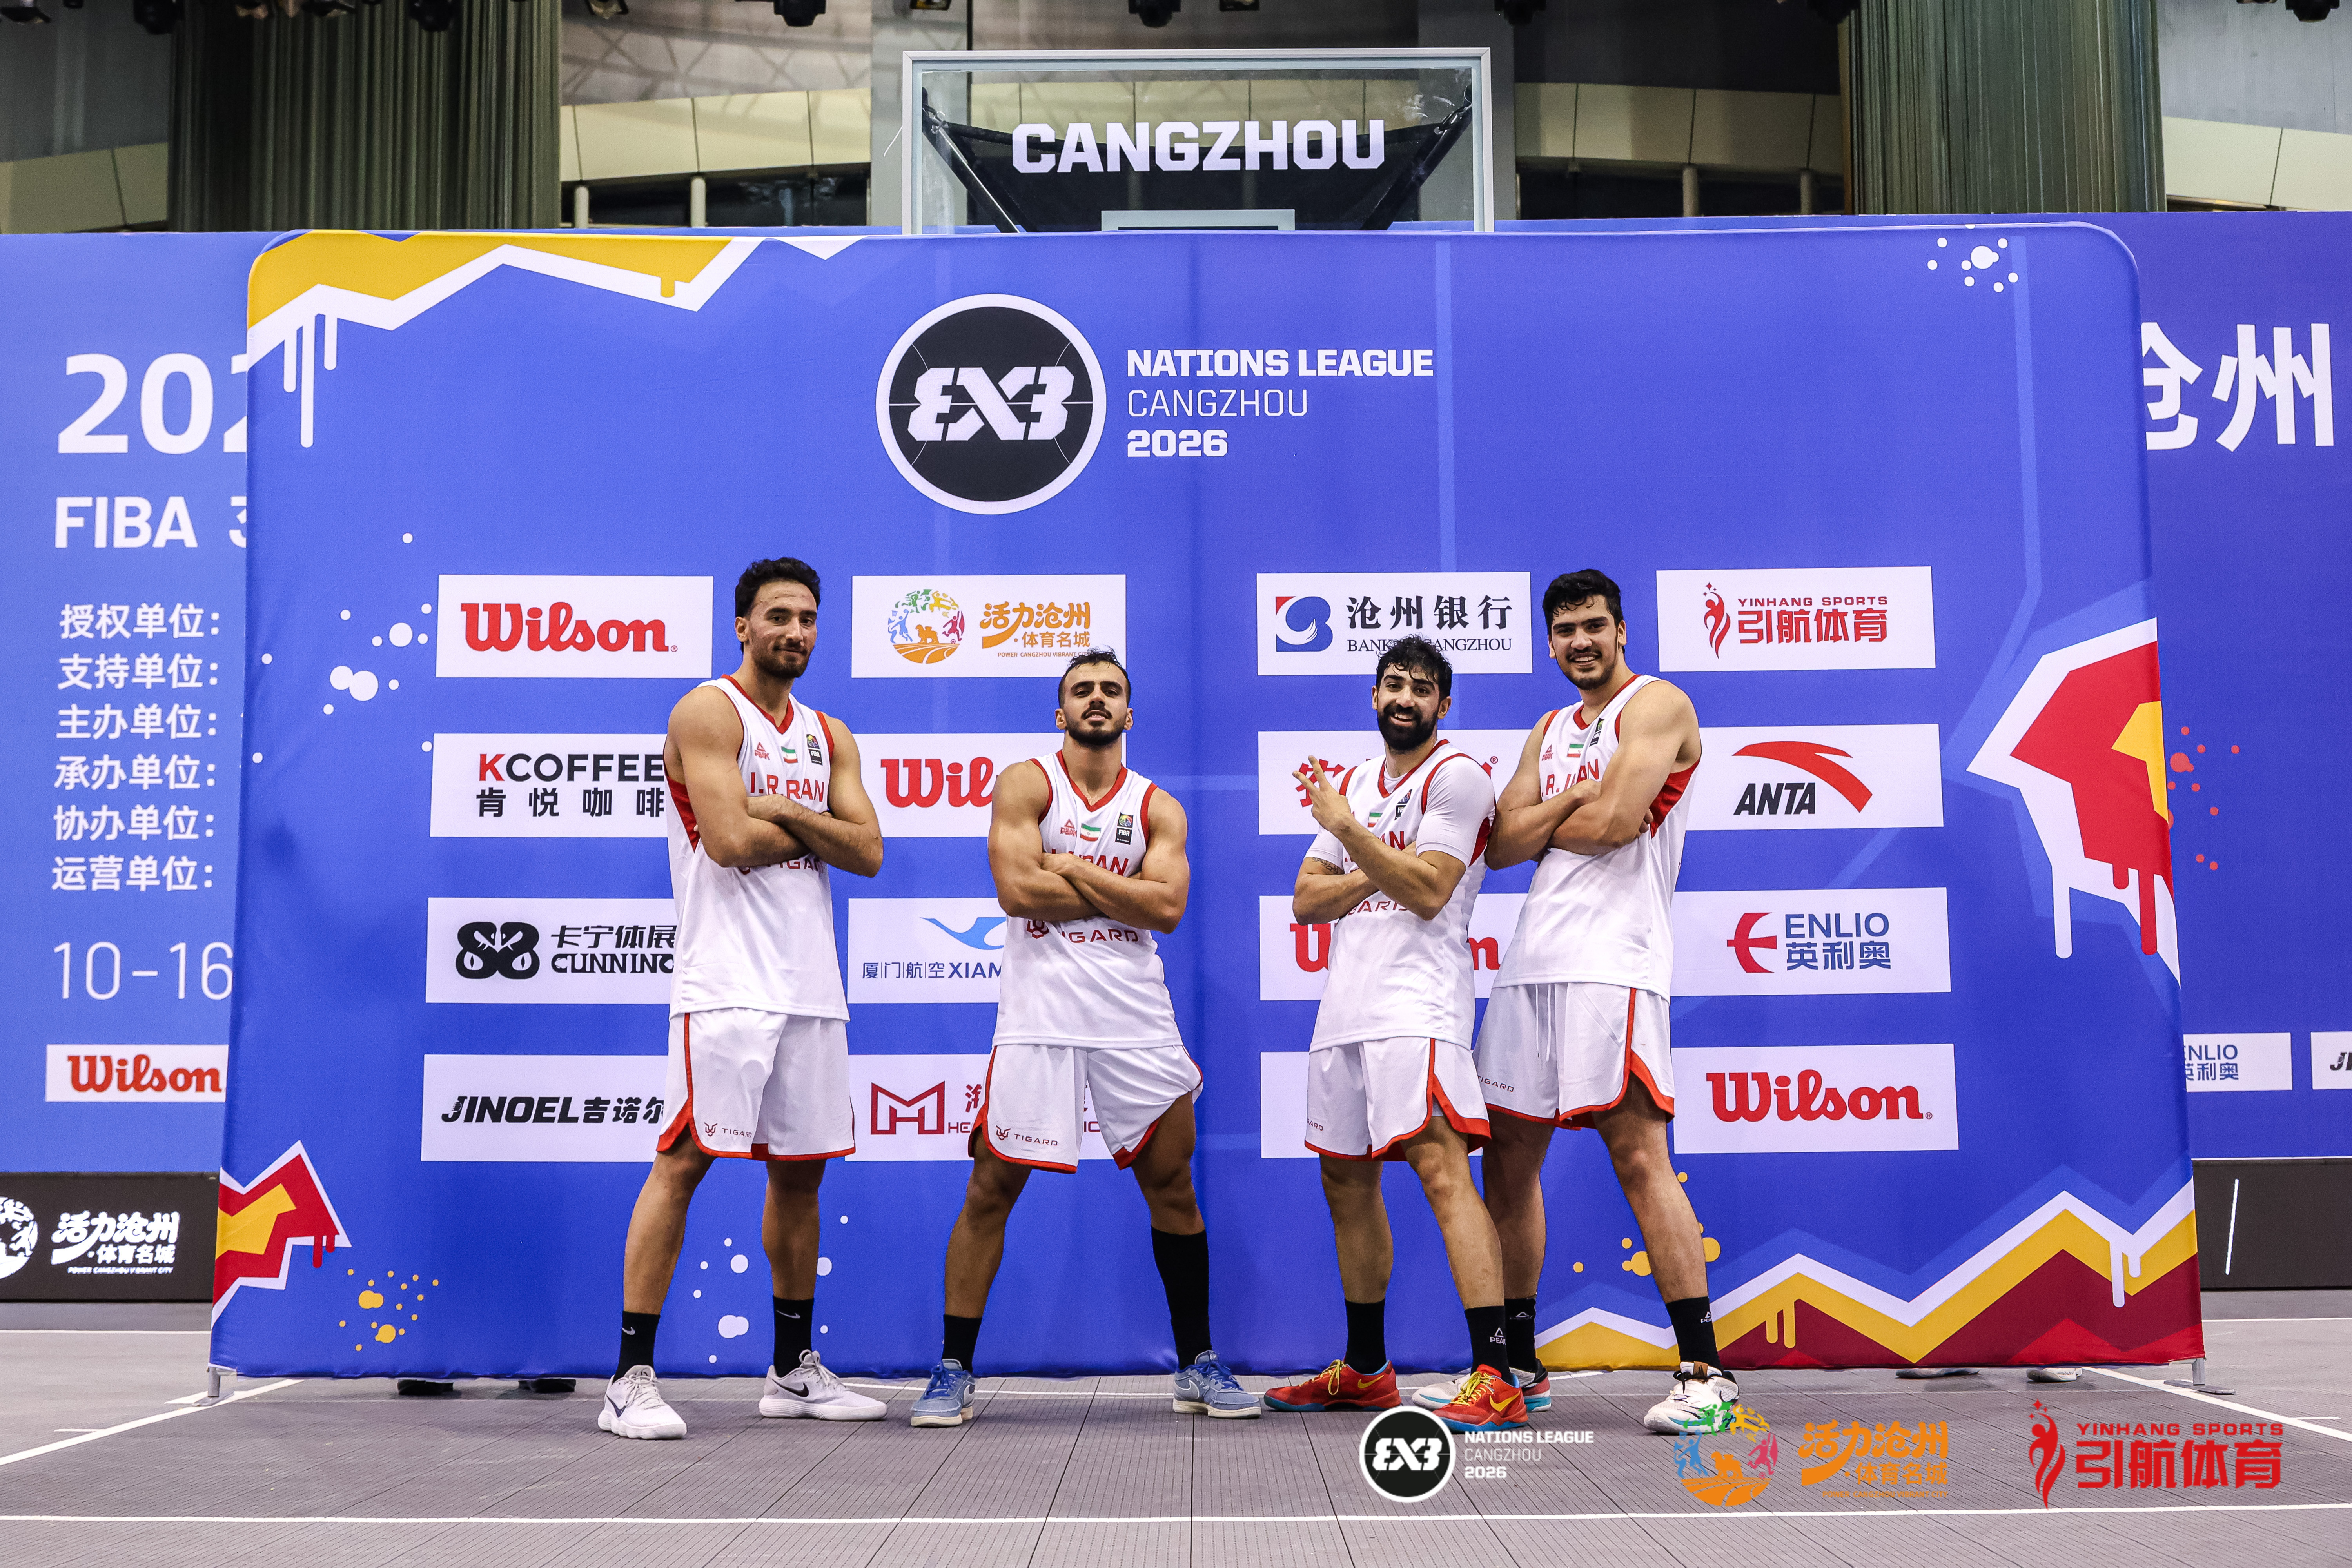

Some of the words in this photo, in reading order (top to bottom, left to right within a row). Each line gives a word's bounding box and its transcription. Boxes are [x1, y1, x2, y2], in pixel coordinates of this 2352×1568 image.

[1012, 120, 1385, 173] CANGZHOU
[1127, 349, 1288, 377] NATIONS
[1298, 349, 1434, 376] LEAGUE
[1127, 389, 1308, 417] CANGZHOU
[1127, 430, 1228, 457] 2026
[55, 496, 198, 548] FIBA
[1346, 595, 1513, 630] 沧州银行
[1737, 597, 1813, 607] YINHANG
[1822, 596, 1888, 605] SPORTS
[460, 601, 669, 652] Wilson
[979, 601, 1091, 648] 活力沧州
[1738, 608, 1888, 644] 引航体育
[479, 753, 665, 782] KCOFFEE
[880, 757, 999, 808] Wil
[476, 787, 665, 818] 肯悦咖啡
[1733, 782, 1816, 815] ANTA
[1785, 913, 1889, 938] ENLIO
[1786, 941, 1891, 971] 英利奥
[2184, 1044, 2238, 1060] NLIO
[67, 1054, 222, 1093] Wilson
[441, 1096, 579, 1123] JINOEL
[1706, 1069, 1924, 1122] Wilson
[1014, 1133, 1058, 1146] TIGARD
[51, 1210, 180, 1265] 活力沧州
